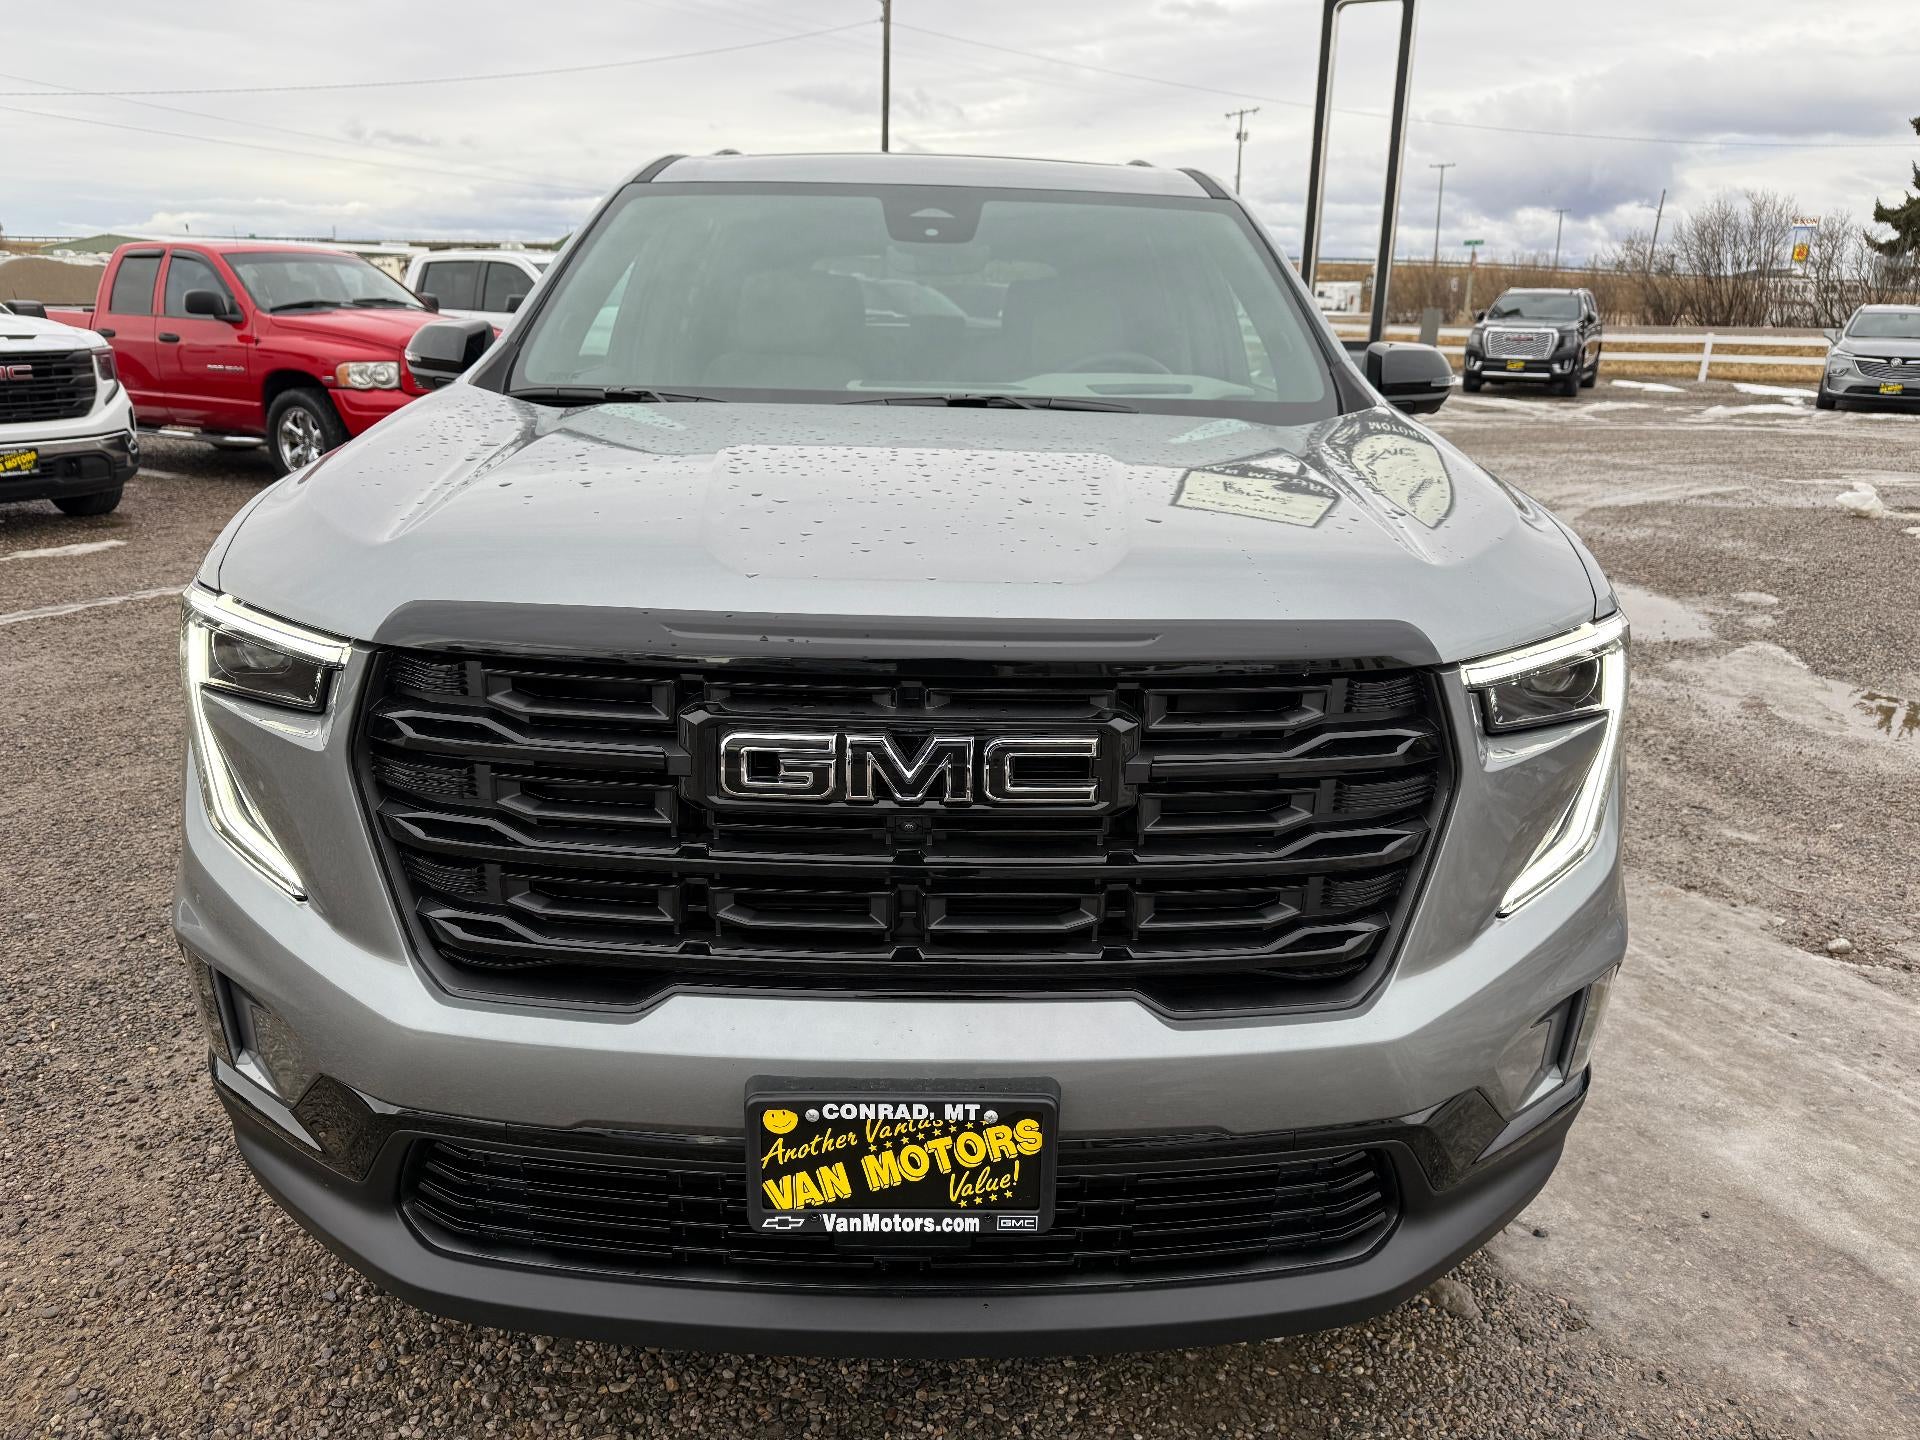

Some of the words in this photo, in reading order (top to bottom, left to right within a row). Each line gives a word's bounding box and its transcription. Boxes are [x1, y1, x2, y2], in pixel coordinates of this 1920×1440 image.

[719, 730, 1099, 805] GMC
[822, 1103, 935, 1120] CONRAD,
[944, 1103, 981, 1121] MT
[760, 1128, 858, 1169] Another
[762, 1161, 852, 1210] VAN
[861, 1119, 1042, 1191] MOTORS
[949, 1160, 1020, 1202] Value!
[822, 1213, 980, 1232] VanMotors.com
